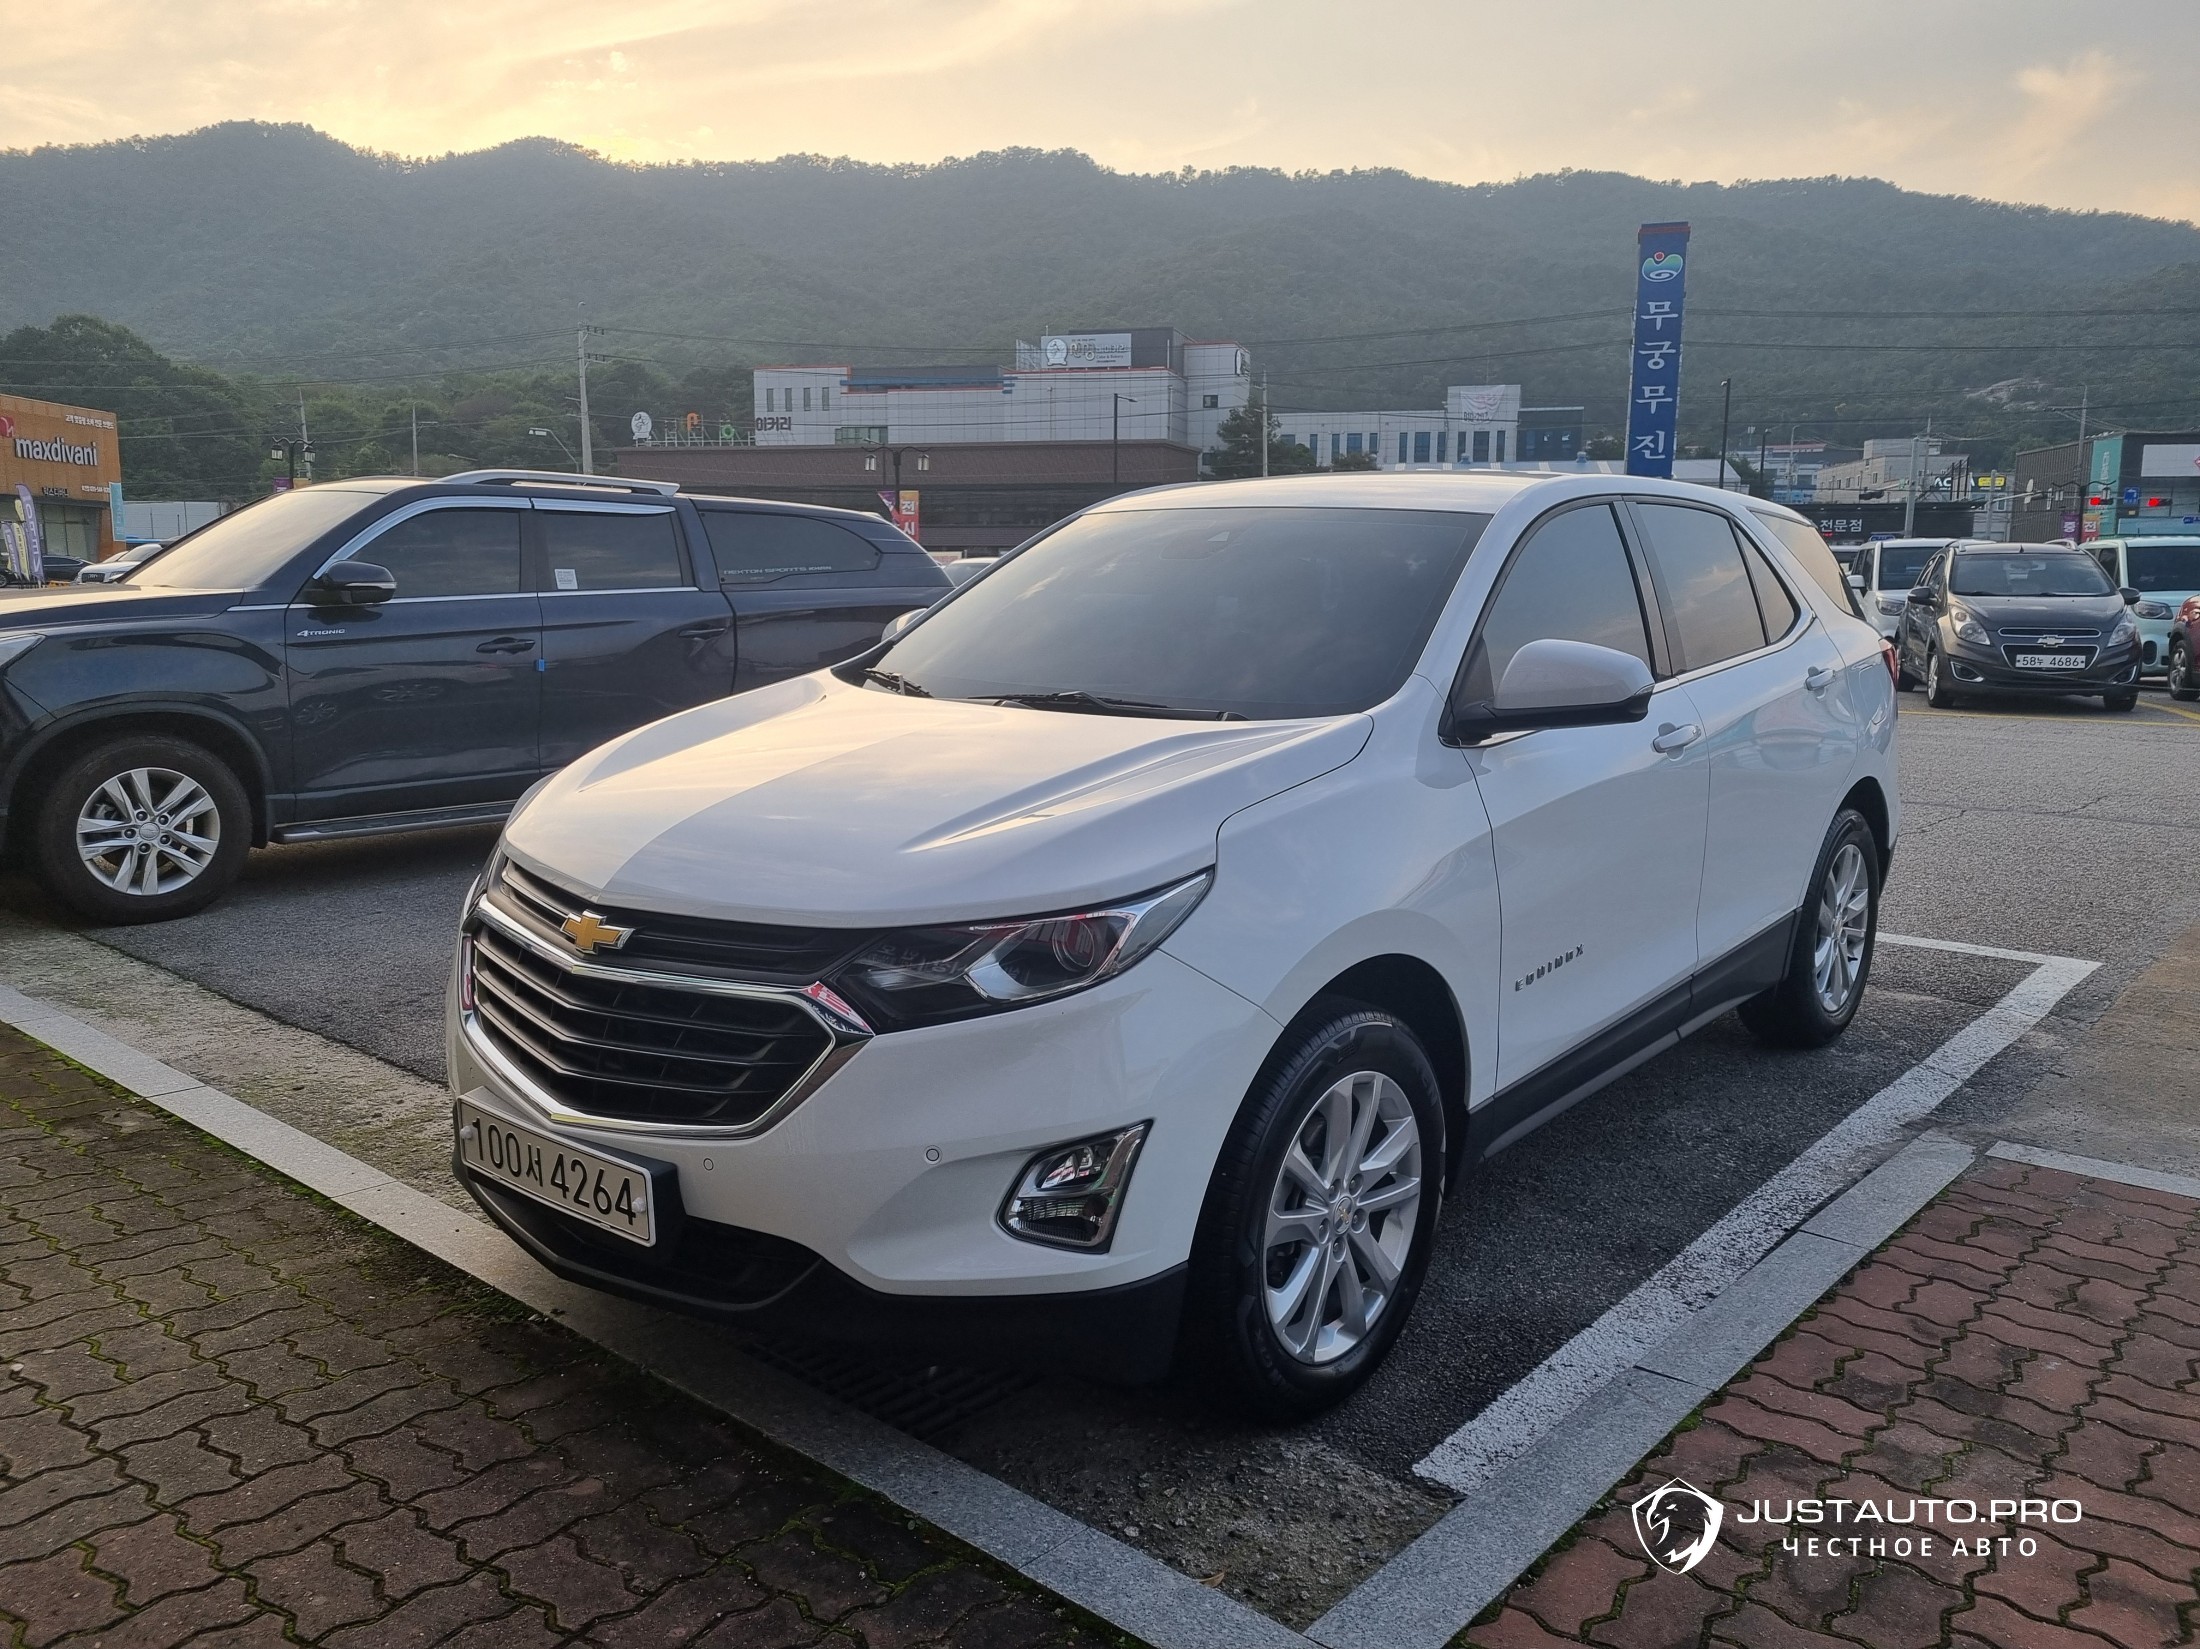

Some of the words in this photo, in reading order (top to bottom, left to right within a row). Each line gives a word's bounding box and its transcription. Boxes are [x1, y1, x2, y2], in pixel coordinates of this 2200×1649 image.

[1632, 301, 1679, 459] 무궁무진
[14, 437, 98, 466] maxdivani
[902, 500, 916, 536] 전시
[1820, 519, 1863, 533] 전문점
[2022, 656, 2044, 666] 58누
[2049, 656, 2080, 667] 4686
